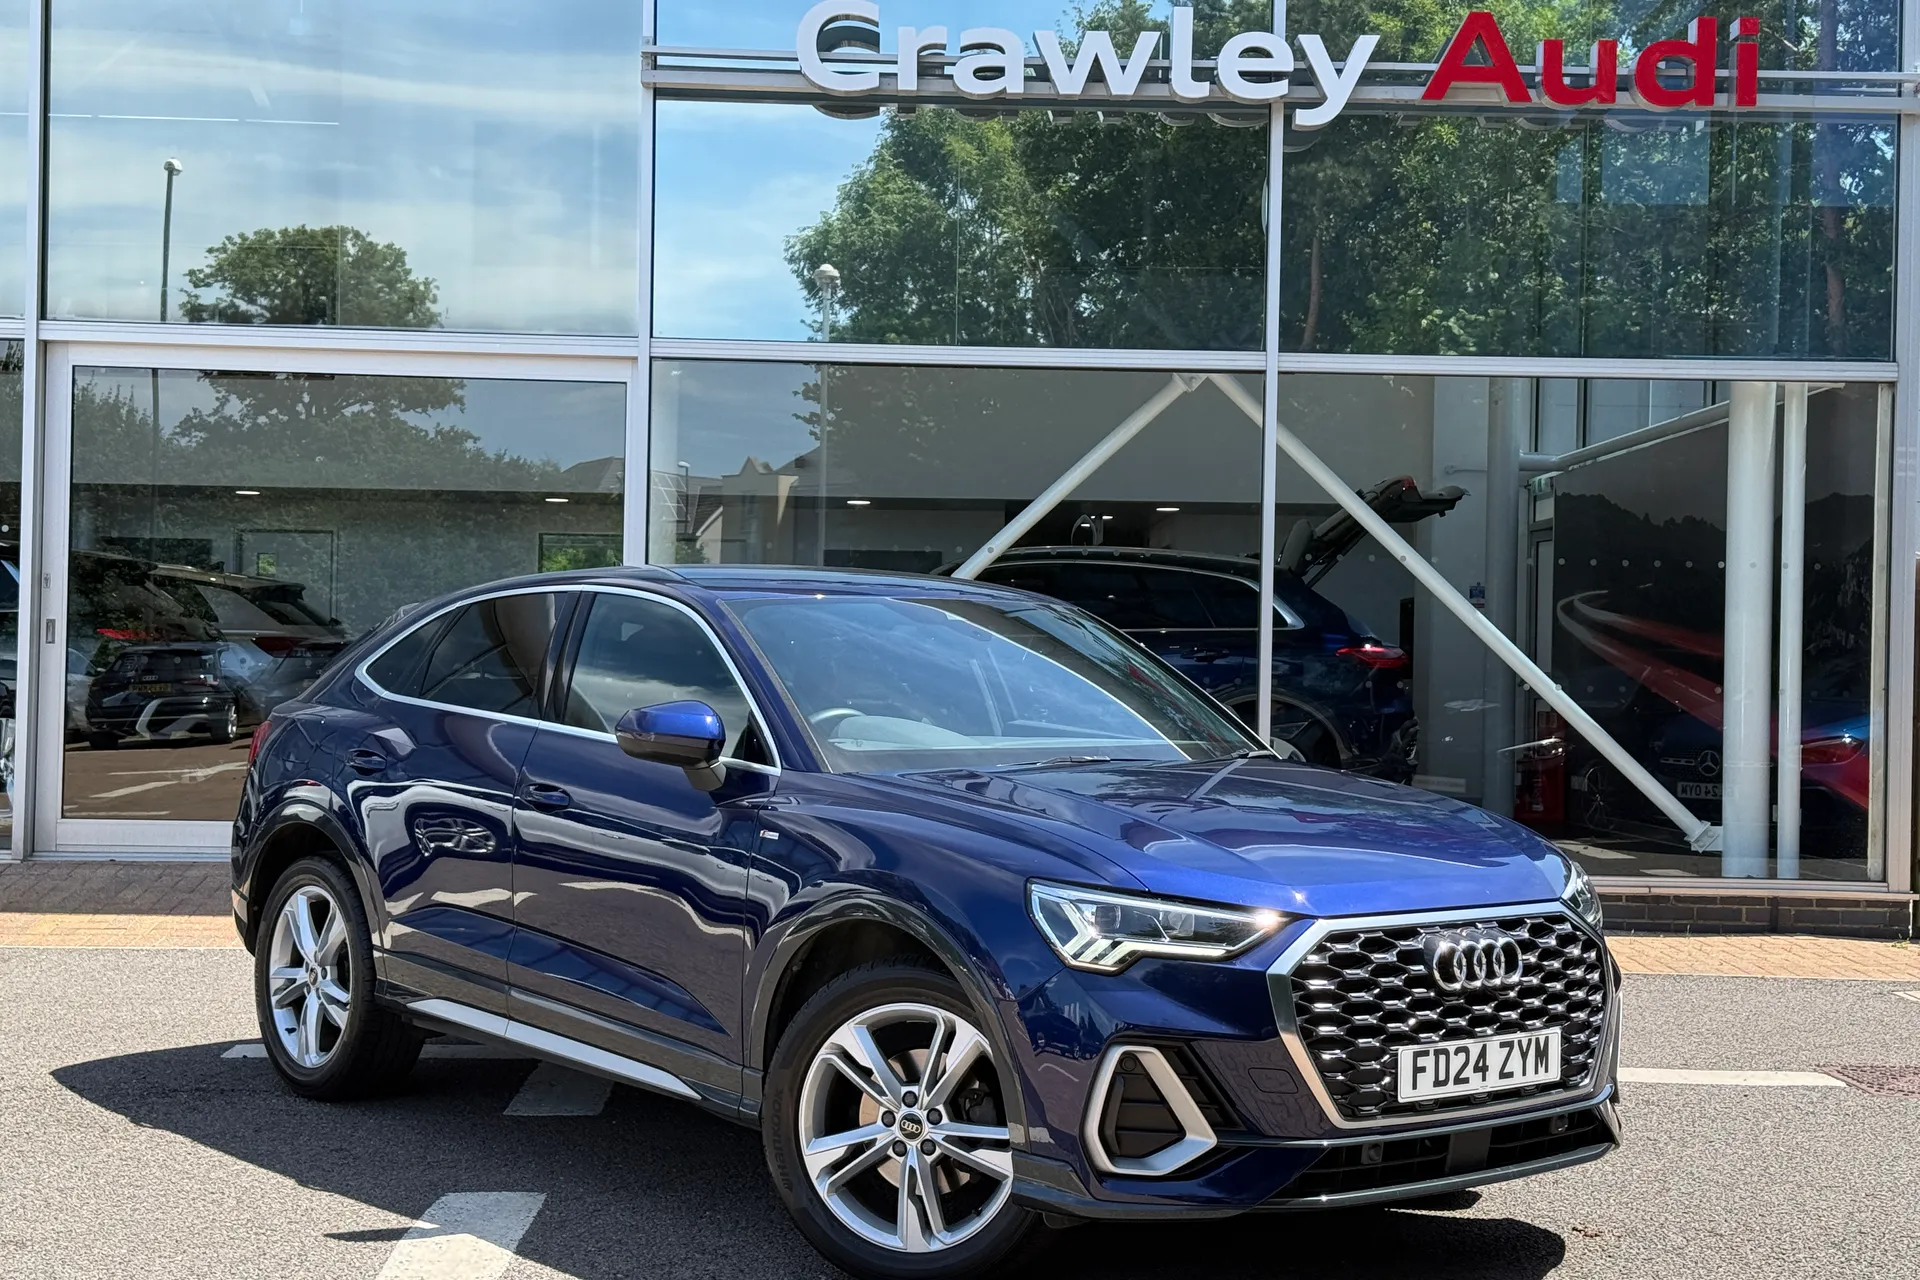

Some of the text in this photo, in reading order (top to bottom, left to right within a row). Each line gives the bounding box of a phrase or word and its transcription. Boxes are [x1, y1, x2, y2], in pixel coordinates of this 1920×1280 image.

[796, 0, 1760, 131] Crawley Audi
[1412, 1036, 1549, 1090] FD24 ZYM
